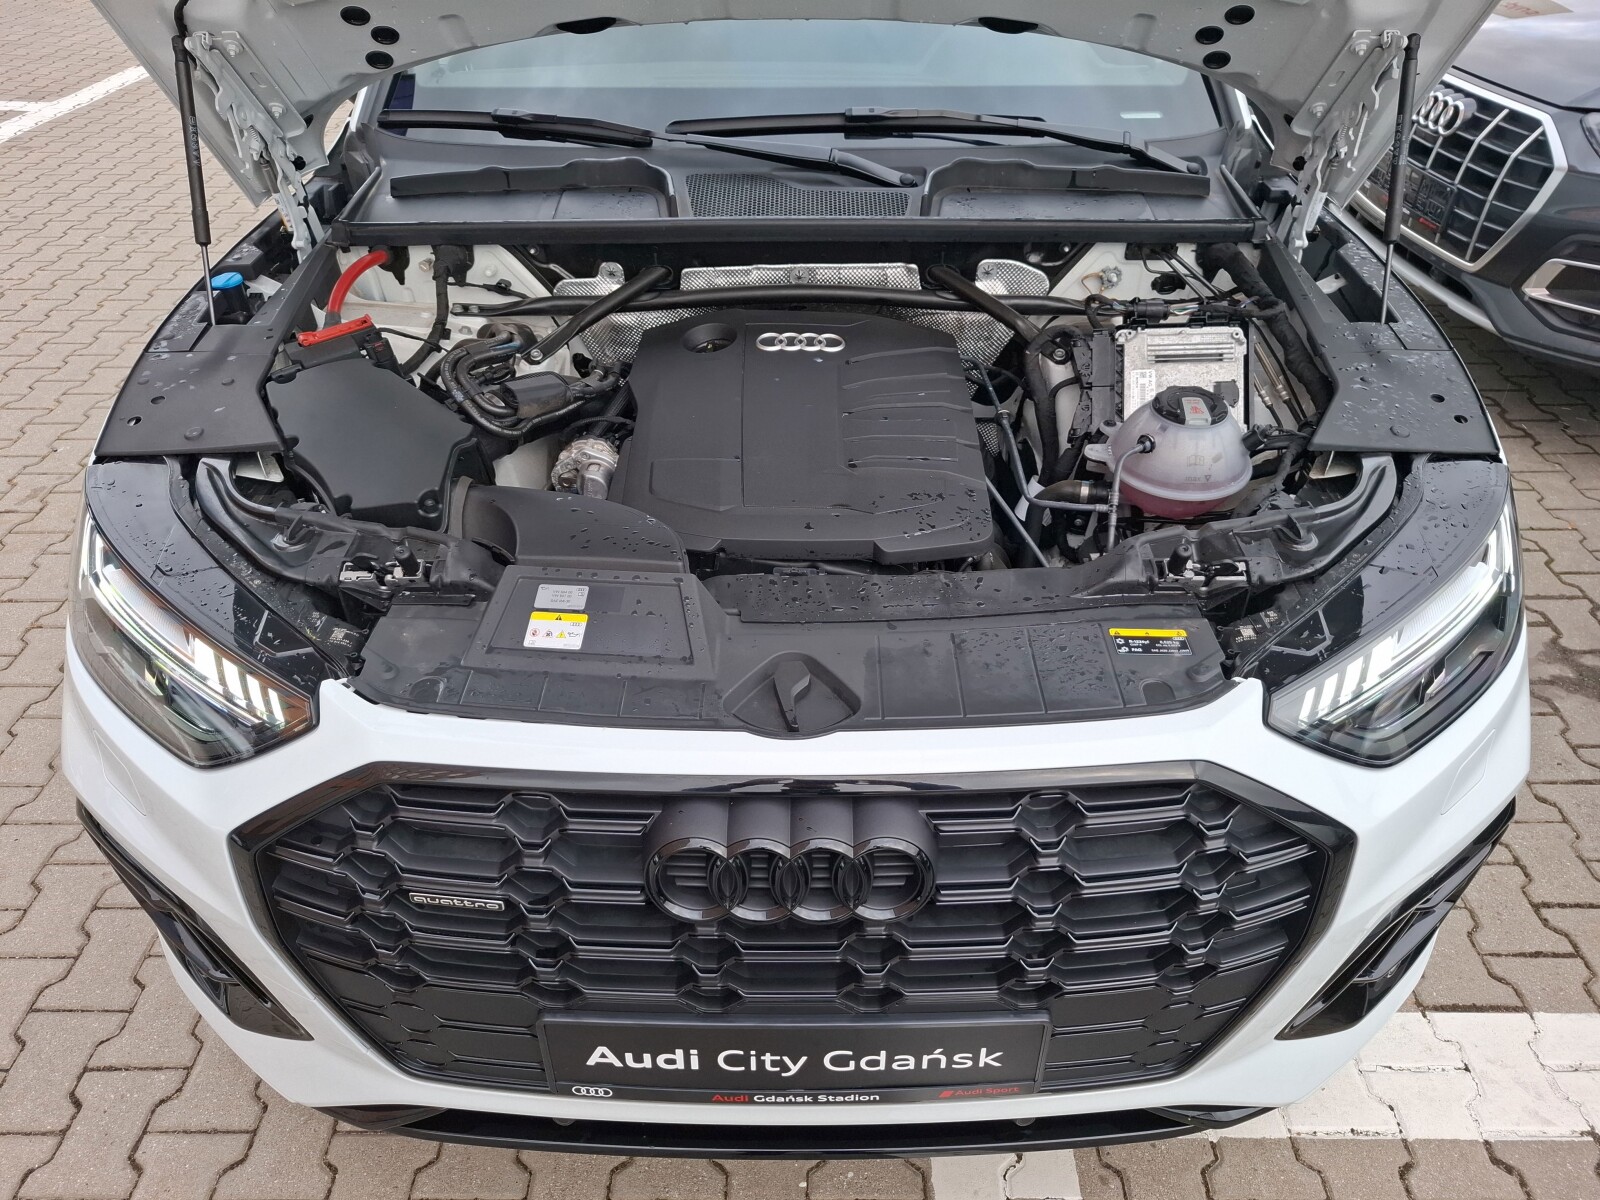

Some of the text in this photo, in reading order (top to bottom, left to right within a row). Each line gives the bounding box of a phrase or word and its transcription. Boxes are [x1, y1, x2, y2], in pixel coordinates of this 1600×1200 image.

[413, 896, 500, 909] quattro
[586, 1046, 1004, 1077] Audi City Gdańsk
[986, 1086, 1020, 1095] Sport
[711, 1094, 880, 1102] Audi Gdańsk Stadion
